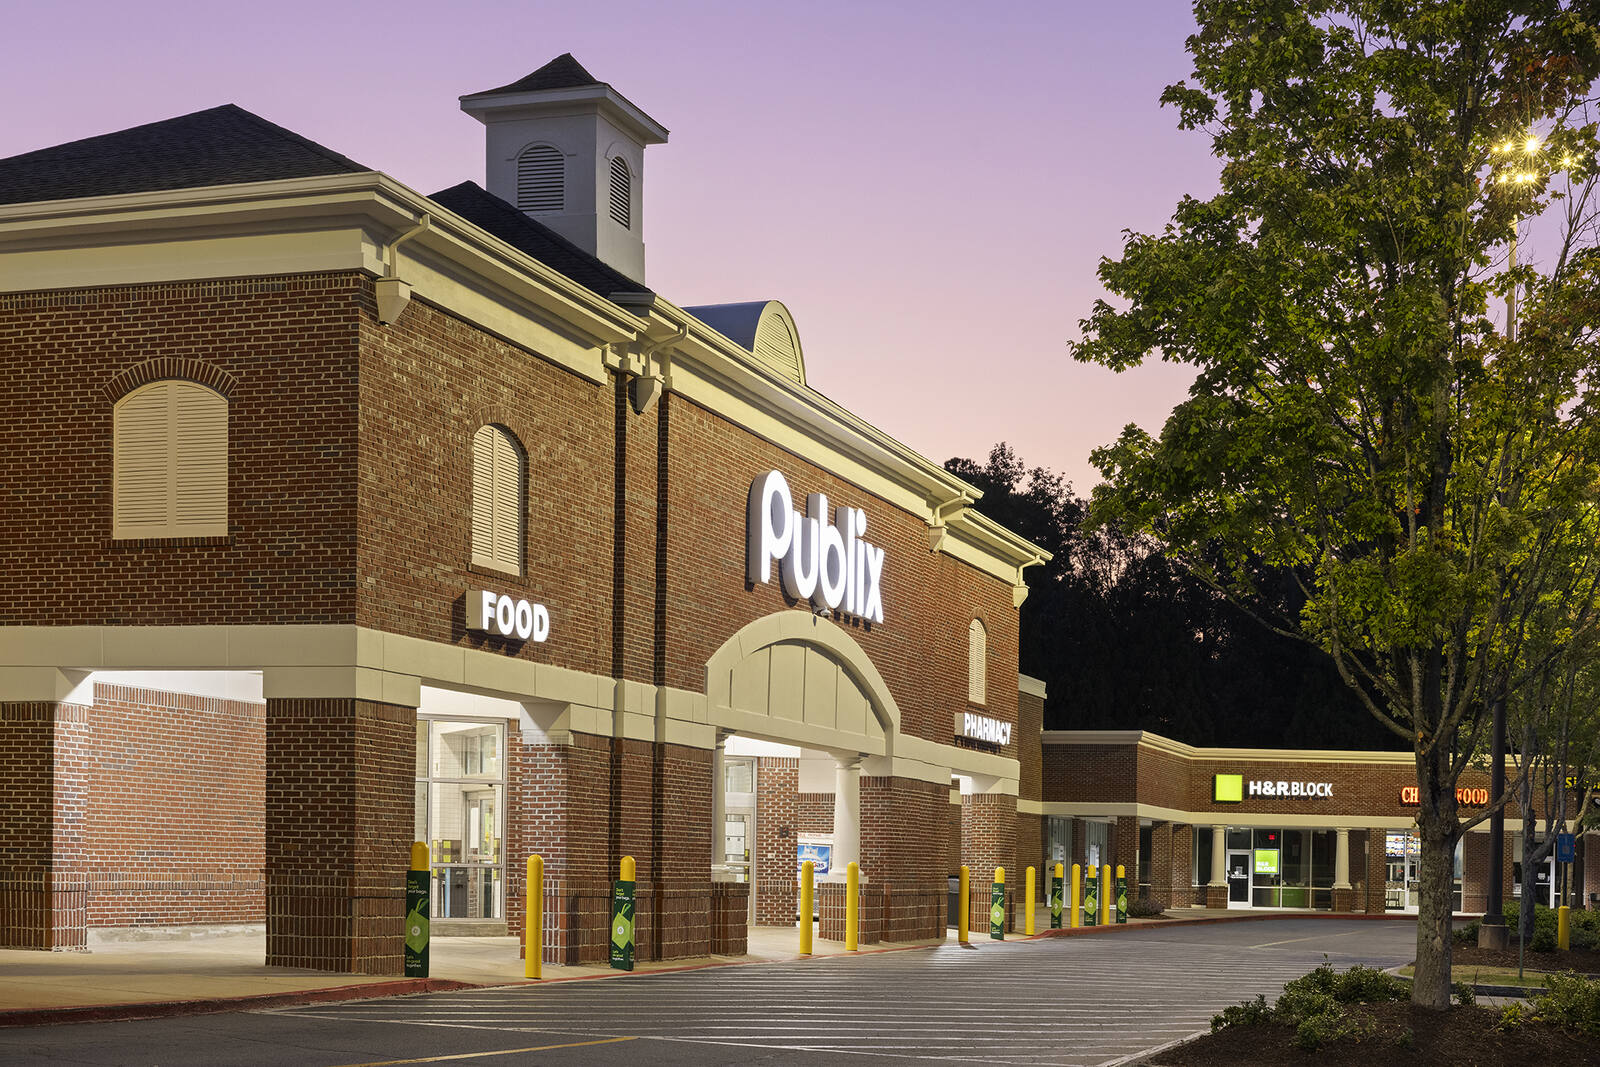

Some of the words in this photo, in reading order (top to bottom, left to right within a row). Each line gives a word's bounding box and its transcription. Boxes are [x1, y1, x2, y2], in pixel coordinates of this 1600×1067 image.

[761, 469, 885, 624] Publix
[482, 590, 550, 643] FOOD
[964, 712, 1012, 746] PHARMACY
[1291, 781, 1334, 797] BLOCK
[1456, 787, 1489, 804] FOOD
